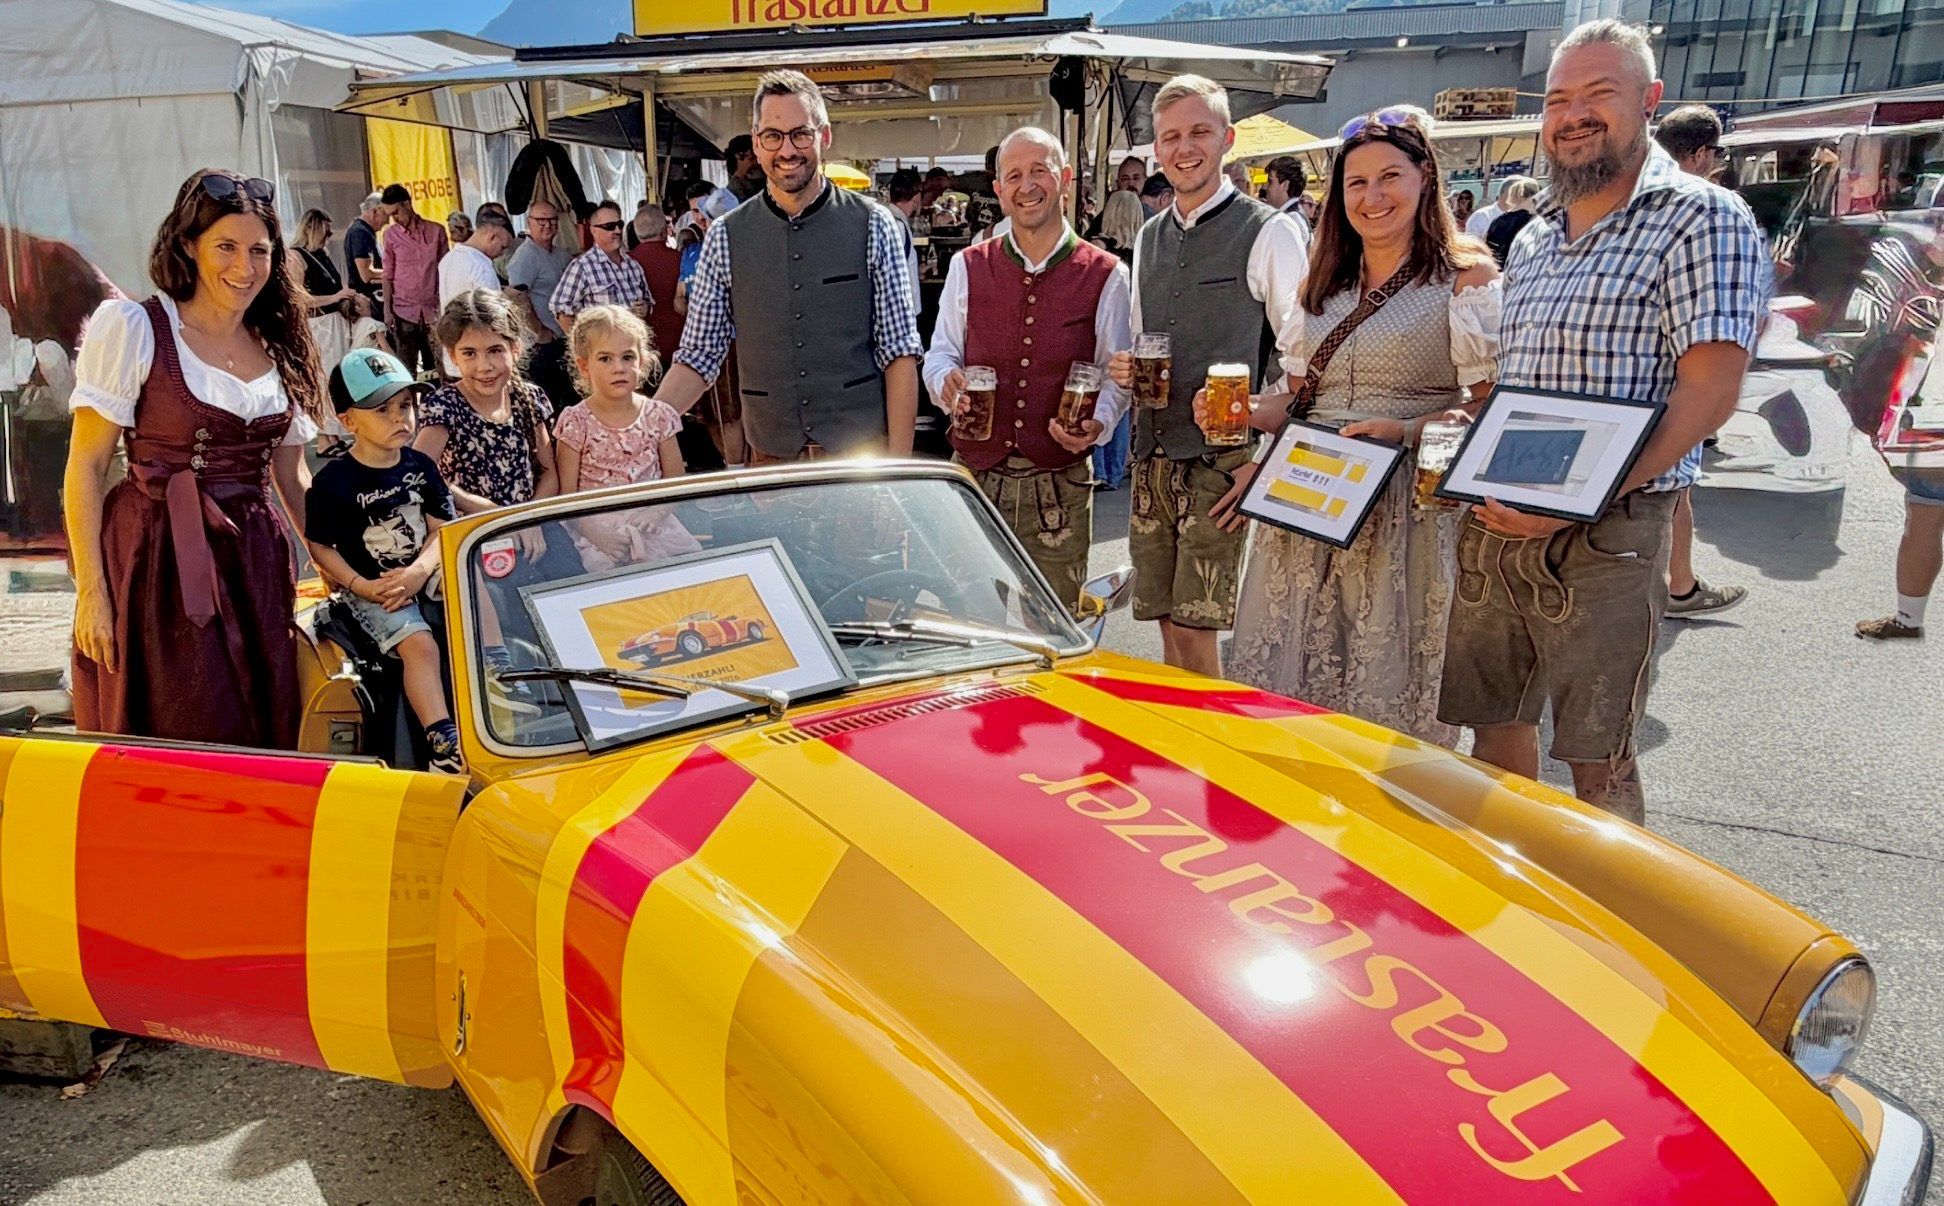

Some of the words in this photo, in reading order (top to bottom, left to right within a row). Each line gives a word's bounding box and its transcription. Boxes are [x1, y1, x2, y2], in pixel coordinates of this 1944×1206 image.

[377, 177, 453, 201] DEROBE
[1018, 771, 1626, 1194] frastanzer
[169, 1026, 282, 1057] Stuhlmayer
